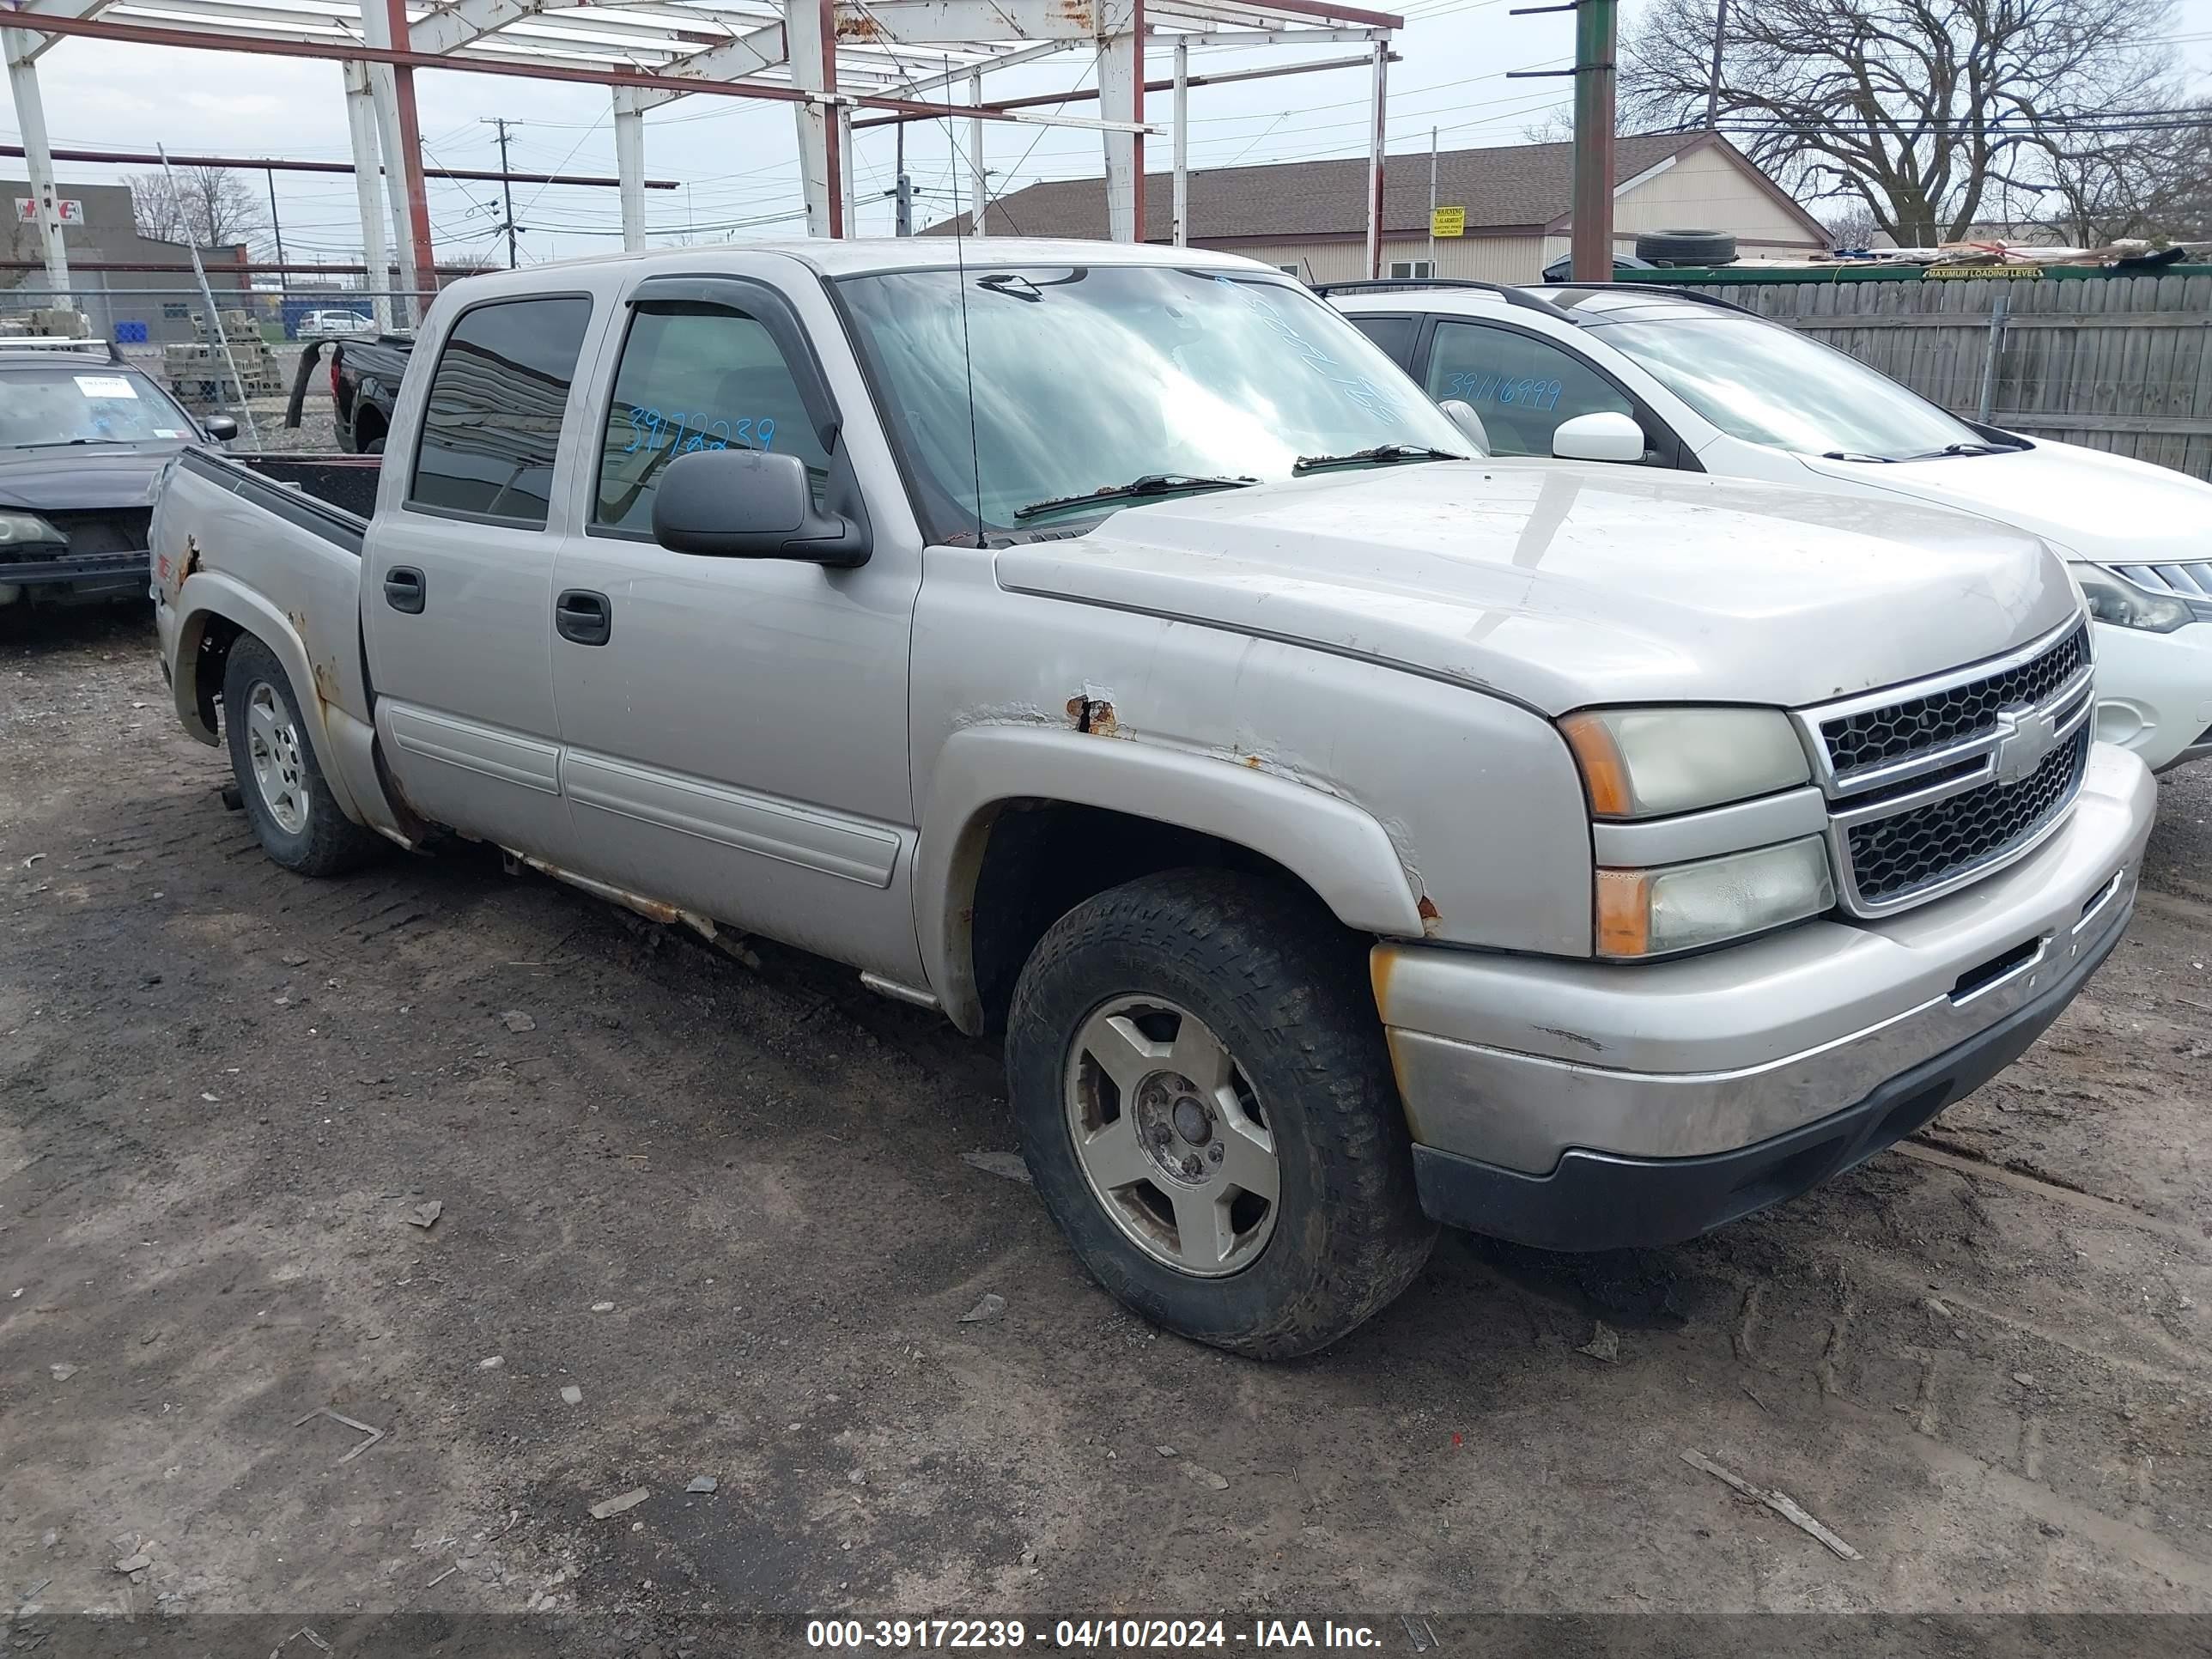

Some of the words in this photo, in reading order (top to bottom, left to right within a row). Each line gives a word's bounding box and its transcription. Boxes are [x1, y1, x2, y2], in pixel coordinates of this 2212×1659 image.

[1970, 269, 2009, 277] LOADING
[2010, 268, 2039, 276] LEVEL
[1443, 372, 1562, 411] 39116999
[624, 407, 775, 455] 39172239
